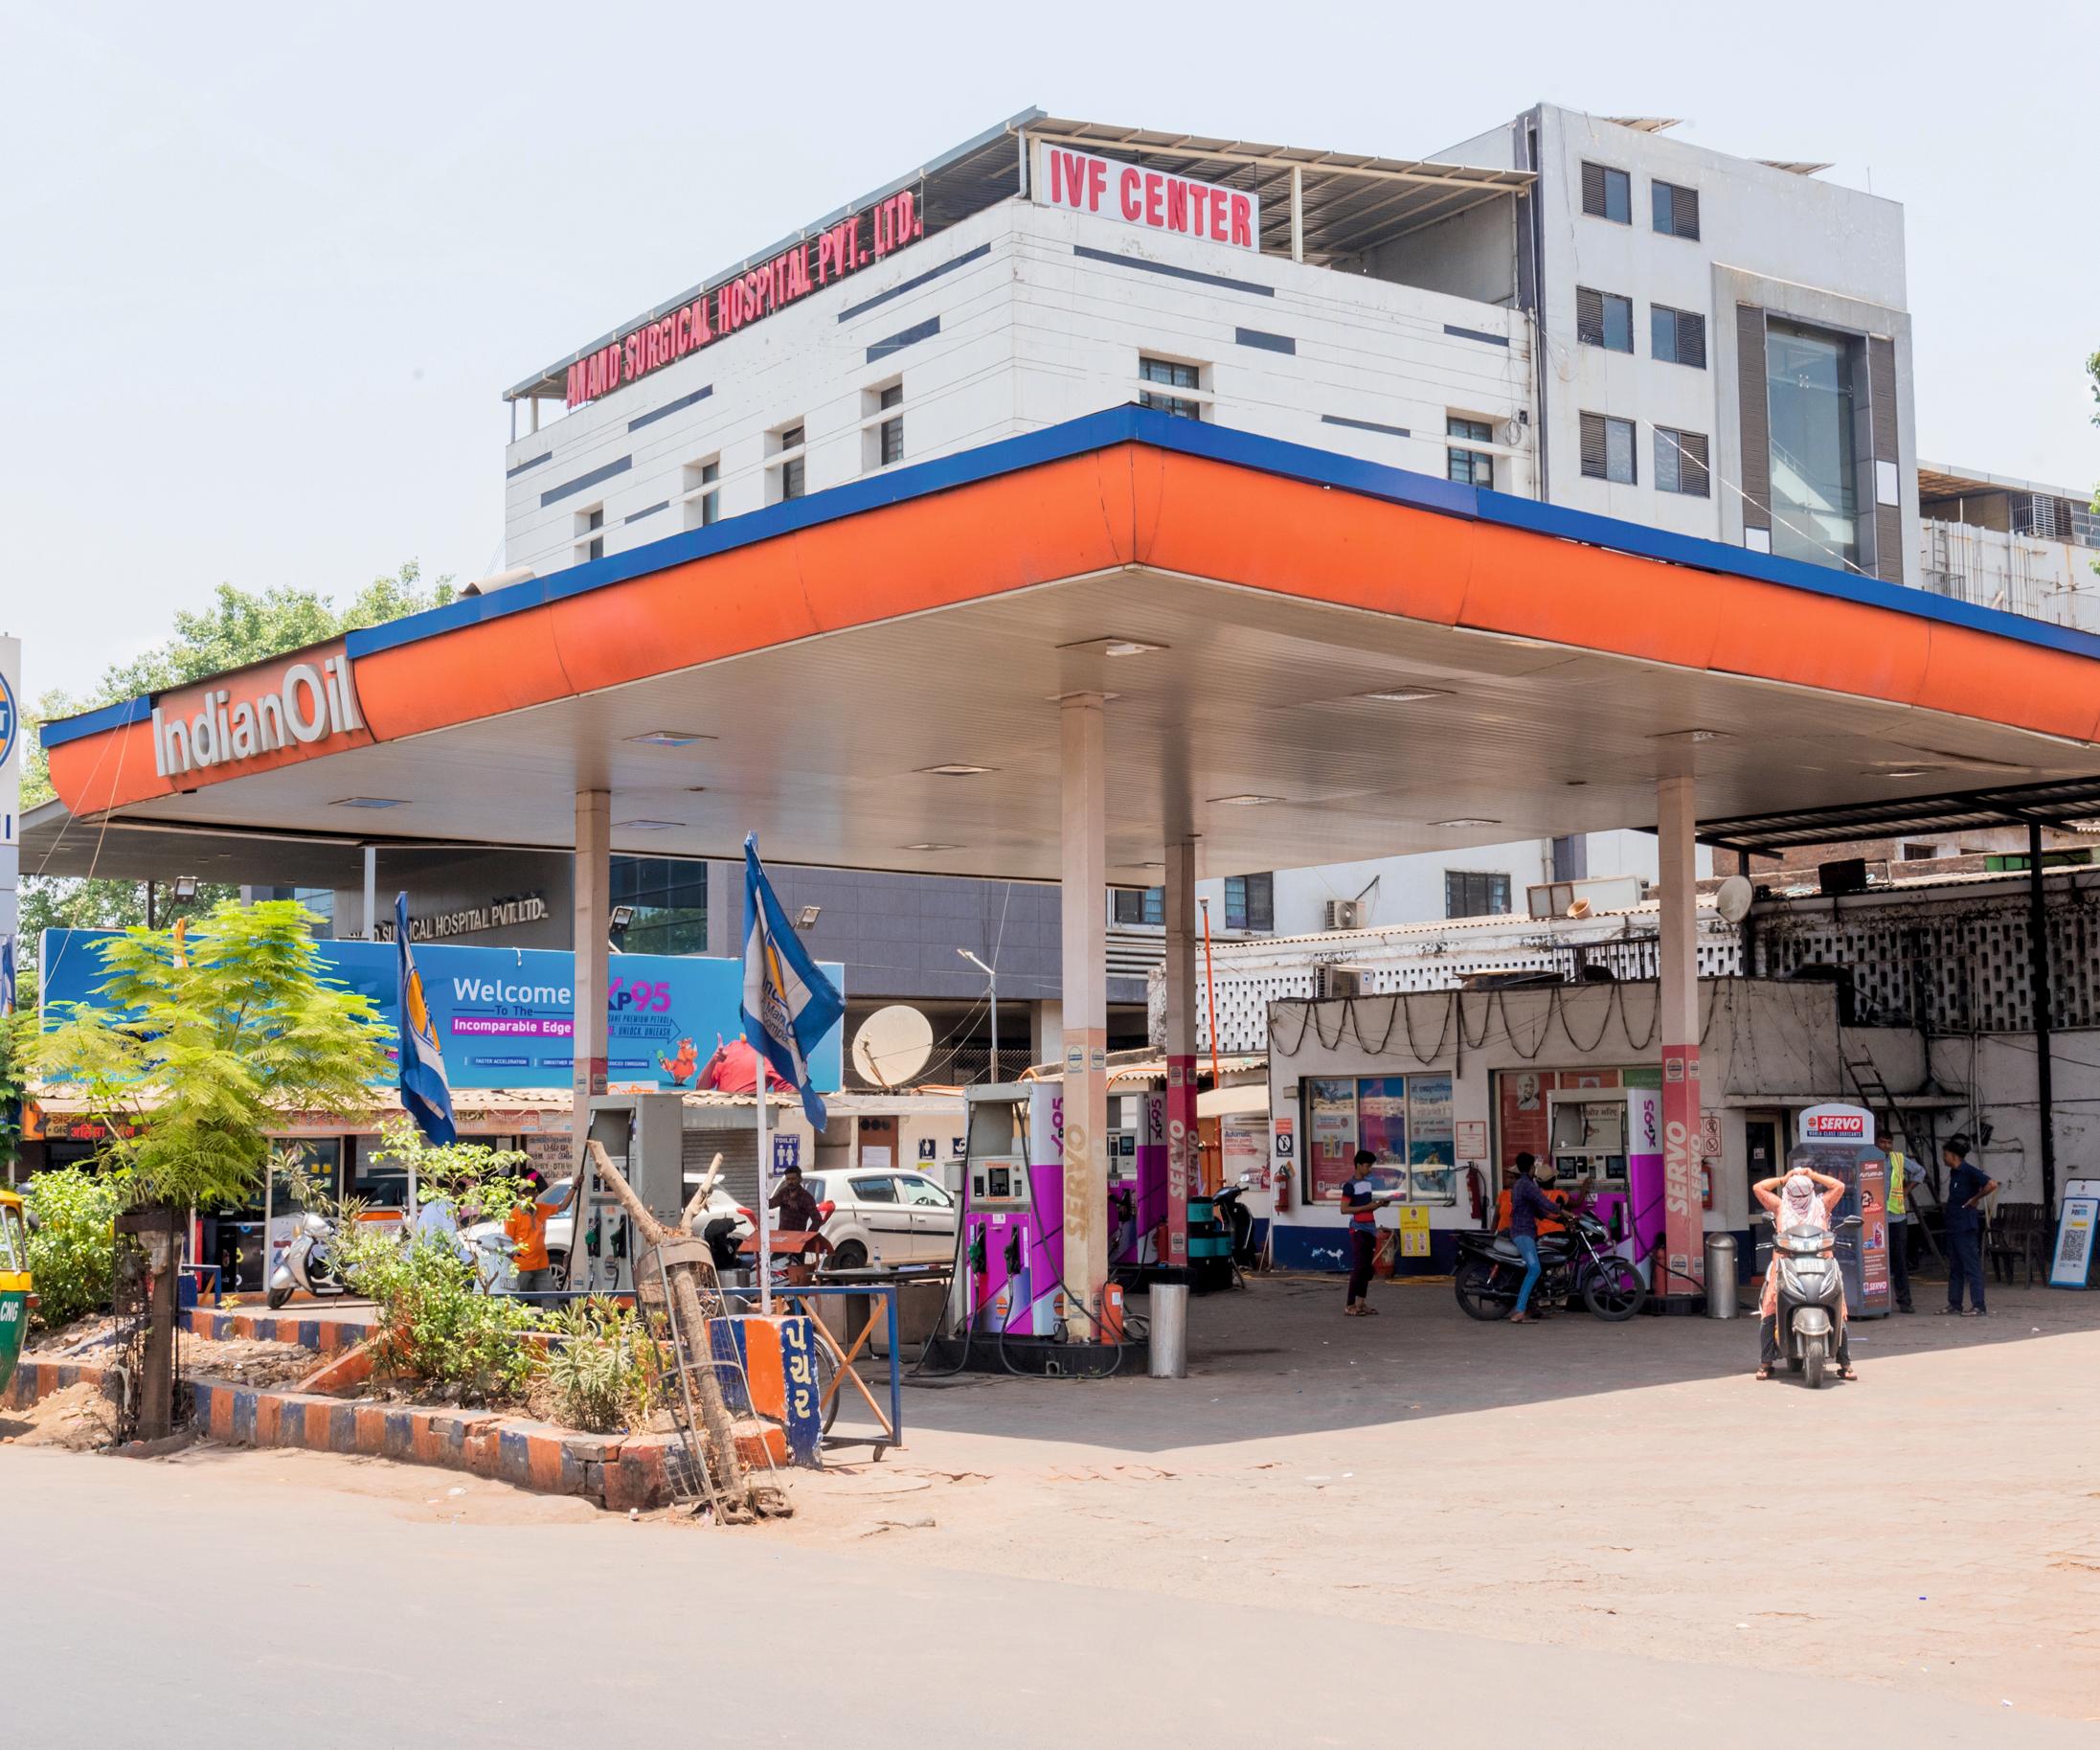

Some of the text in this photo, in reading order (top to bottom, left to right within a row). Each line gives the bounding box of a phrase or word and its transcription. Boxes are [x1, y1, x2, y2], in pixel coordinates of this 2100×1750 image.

[1050, 149, 1253, 248] IVF CENTER
[566, 190, 923, 410] ANAND SURGICAL HOSPITAL PVT. LTD.
[151, 654, 364, 778] IndianOil
[382, 917, 433, 943] SUICAL
[436, 909, 489, 938] HOSPITAL
[491, 902, 517, 928] PVT.
[518, 898, 549, 922] LTD.
[453, 977, 572, 1005] Welcome
[495, 1005, 533, 1016] To The
[454, 1019, 572, 1035] Incomparable Edge
[622, 1015, 649, 1024] PREMIUM
[454, 1110, 485, 1121] EROX
[1152, 1099, 1163, 1141] XP95
[1643, 1099, 1657, 1148] XP95
[1820, 1117, 1862, 1131] SERVO
[1169, 1120, 1185, 1201] SERVO
[1187, 1130, 1198, 1189] SERVO
[1666, 1121, 1688, 1217] SERVO
[1690, 1134, 1702, 1202] SERVO
[1065, 1123, 1088, 1242] SERVO
[1868, 1282, 1886, 1291] SERVO
[0, 1301, 19, 1322] CNG
